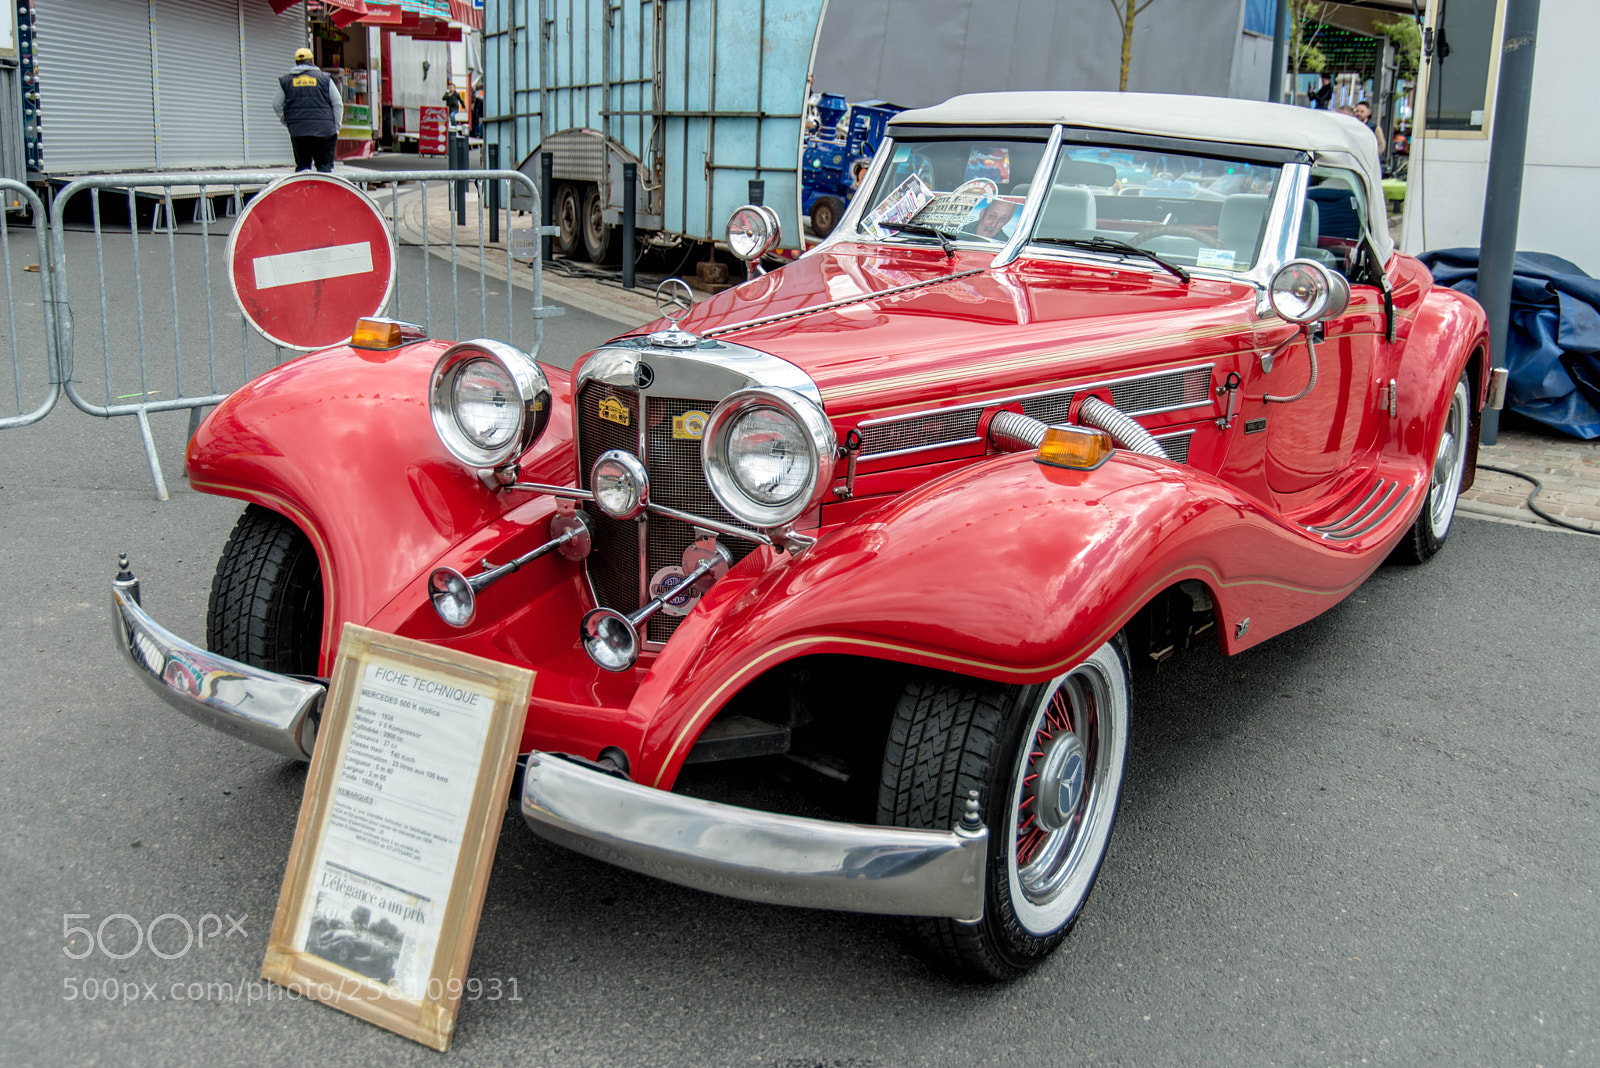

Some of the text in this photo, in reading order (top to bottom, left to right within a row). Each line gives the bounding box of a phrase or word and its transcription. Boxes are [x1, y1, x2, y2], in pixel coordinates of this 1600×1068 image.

[362, 688, 398, 704] MERCEDES
[399, 699, 412, 709] 500
[374, 667, 480, 705] FICHE TECHNIQUE
[321, 872, 377, 906] L'élégance
[378, 898, 387, 909] a
[388, 901, 403, 916] un
[402, 905, 427, 925] prix
